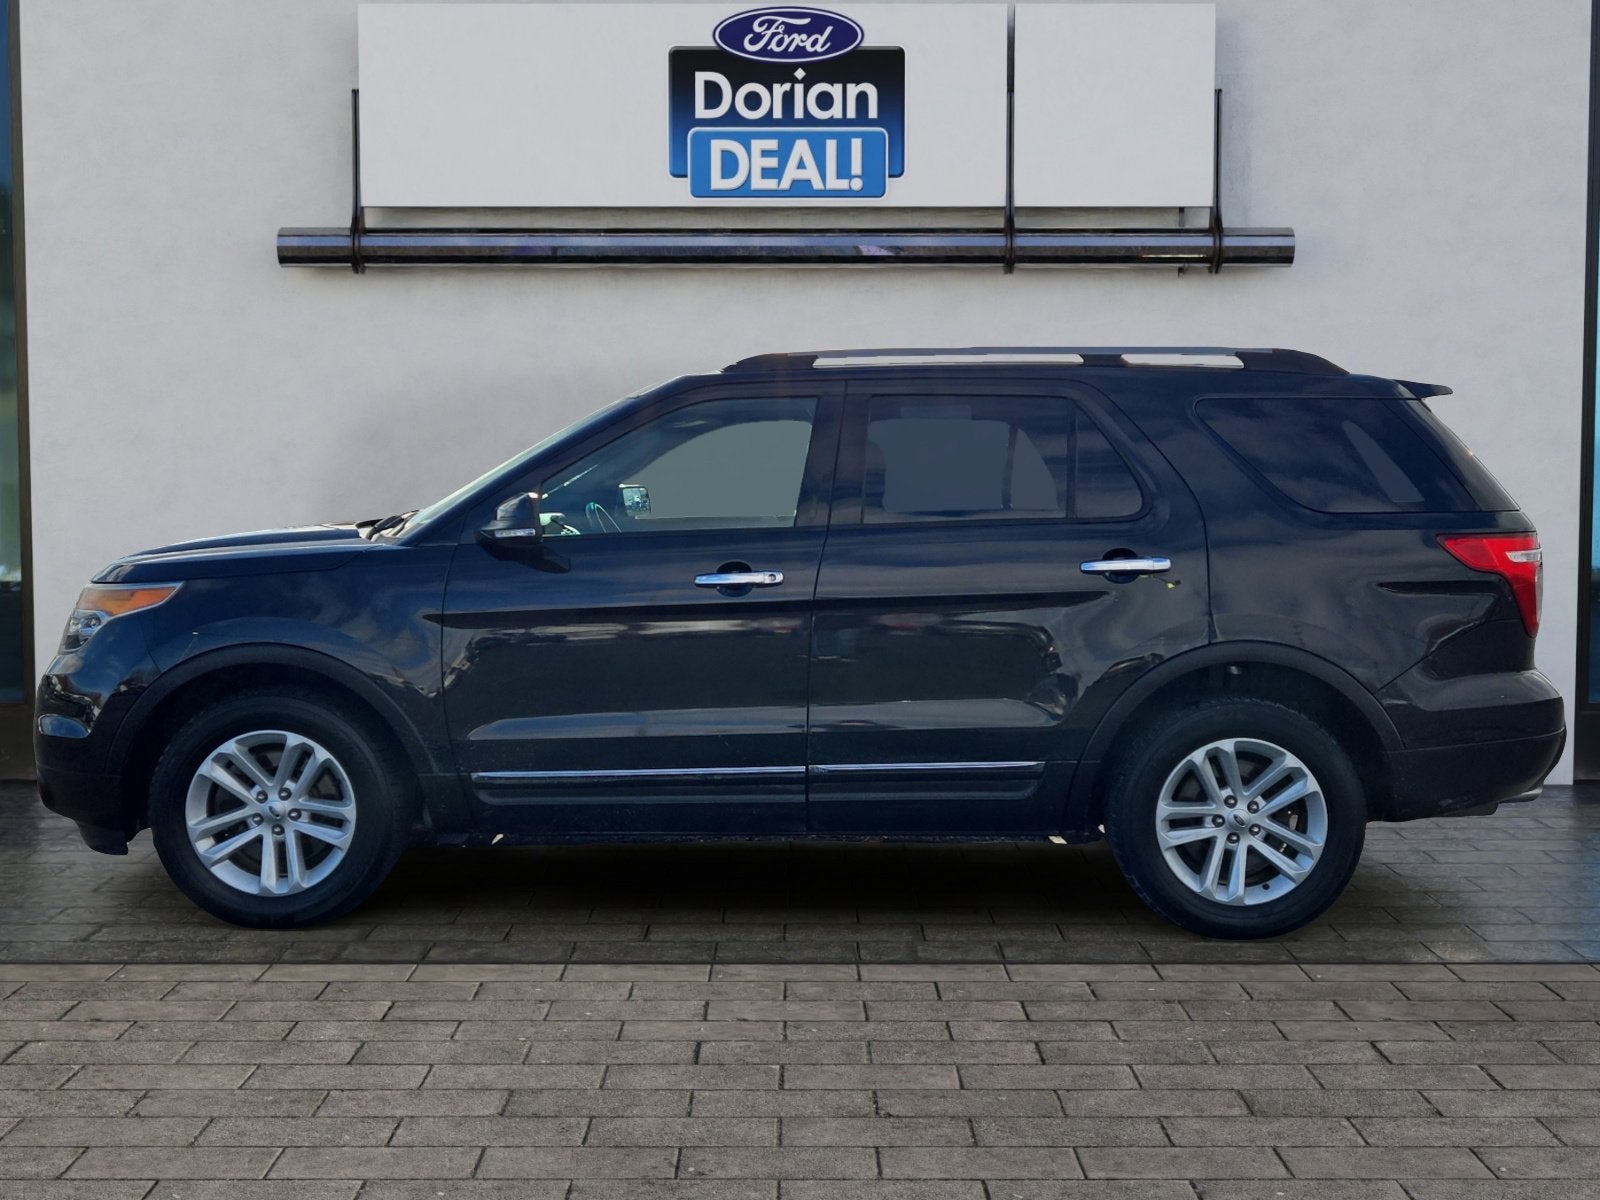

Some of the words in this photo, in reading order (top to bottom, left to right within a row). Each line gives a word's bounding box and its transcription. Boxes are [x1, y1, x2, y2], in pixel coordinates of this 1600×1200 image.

[743, 15, 833, 52] Ford
[694, 67, 879, 120] Dorian
[710, 137, 863, 191] DEAL!
